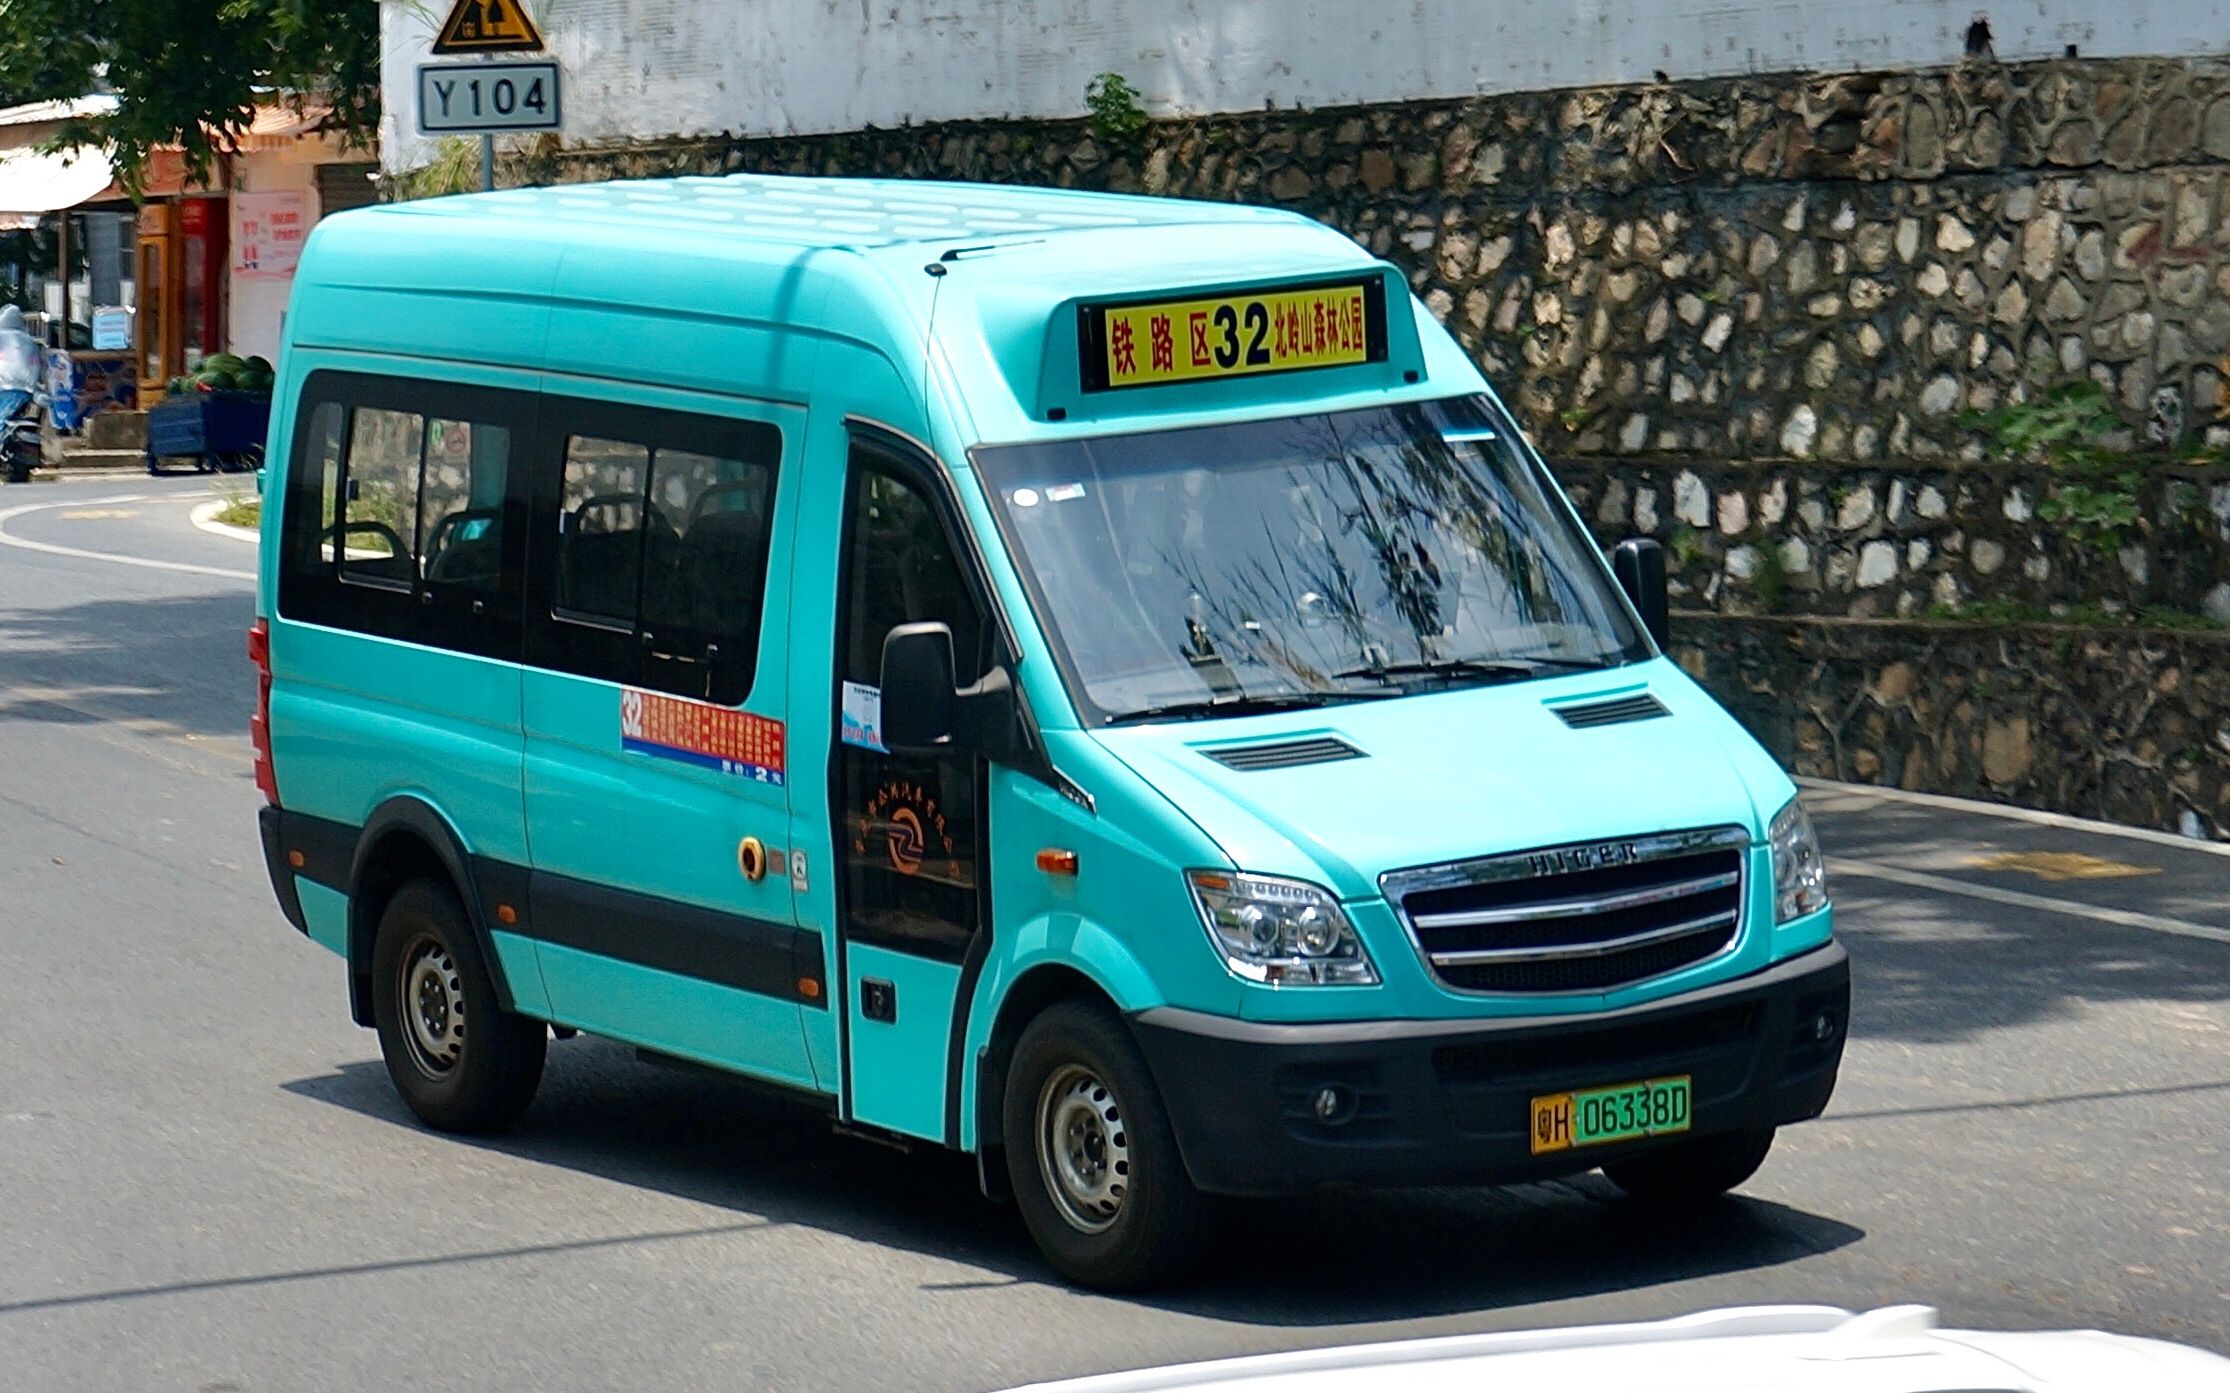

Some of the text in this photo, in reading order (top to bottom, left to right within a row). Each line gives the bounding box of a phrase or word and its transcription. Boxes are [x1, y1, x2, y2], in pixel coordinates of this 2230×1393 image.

[432, 77, 547, 118] Y104
[1213, 302, 1271, 369] 32
[622, 690, 643, 738] 32
[1528, 842, 1640, 877] HIGER
